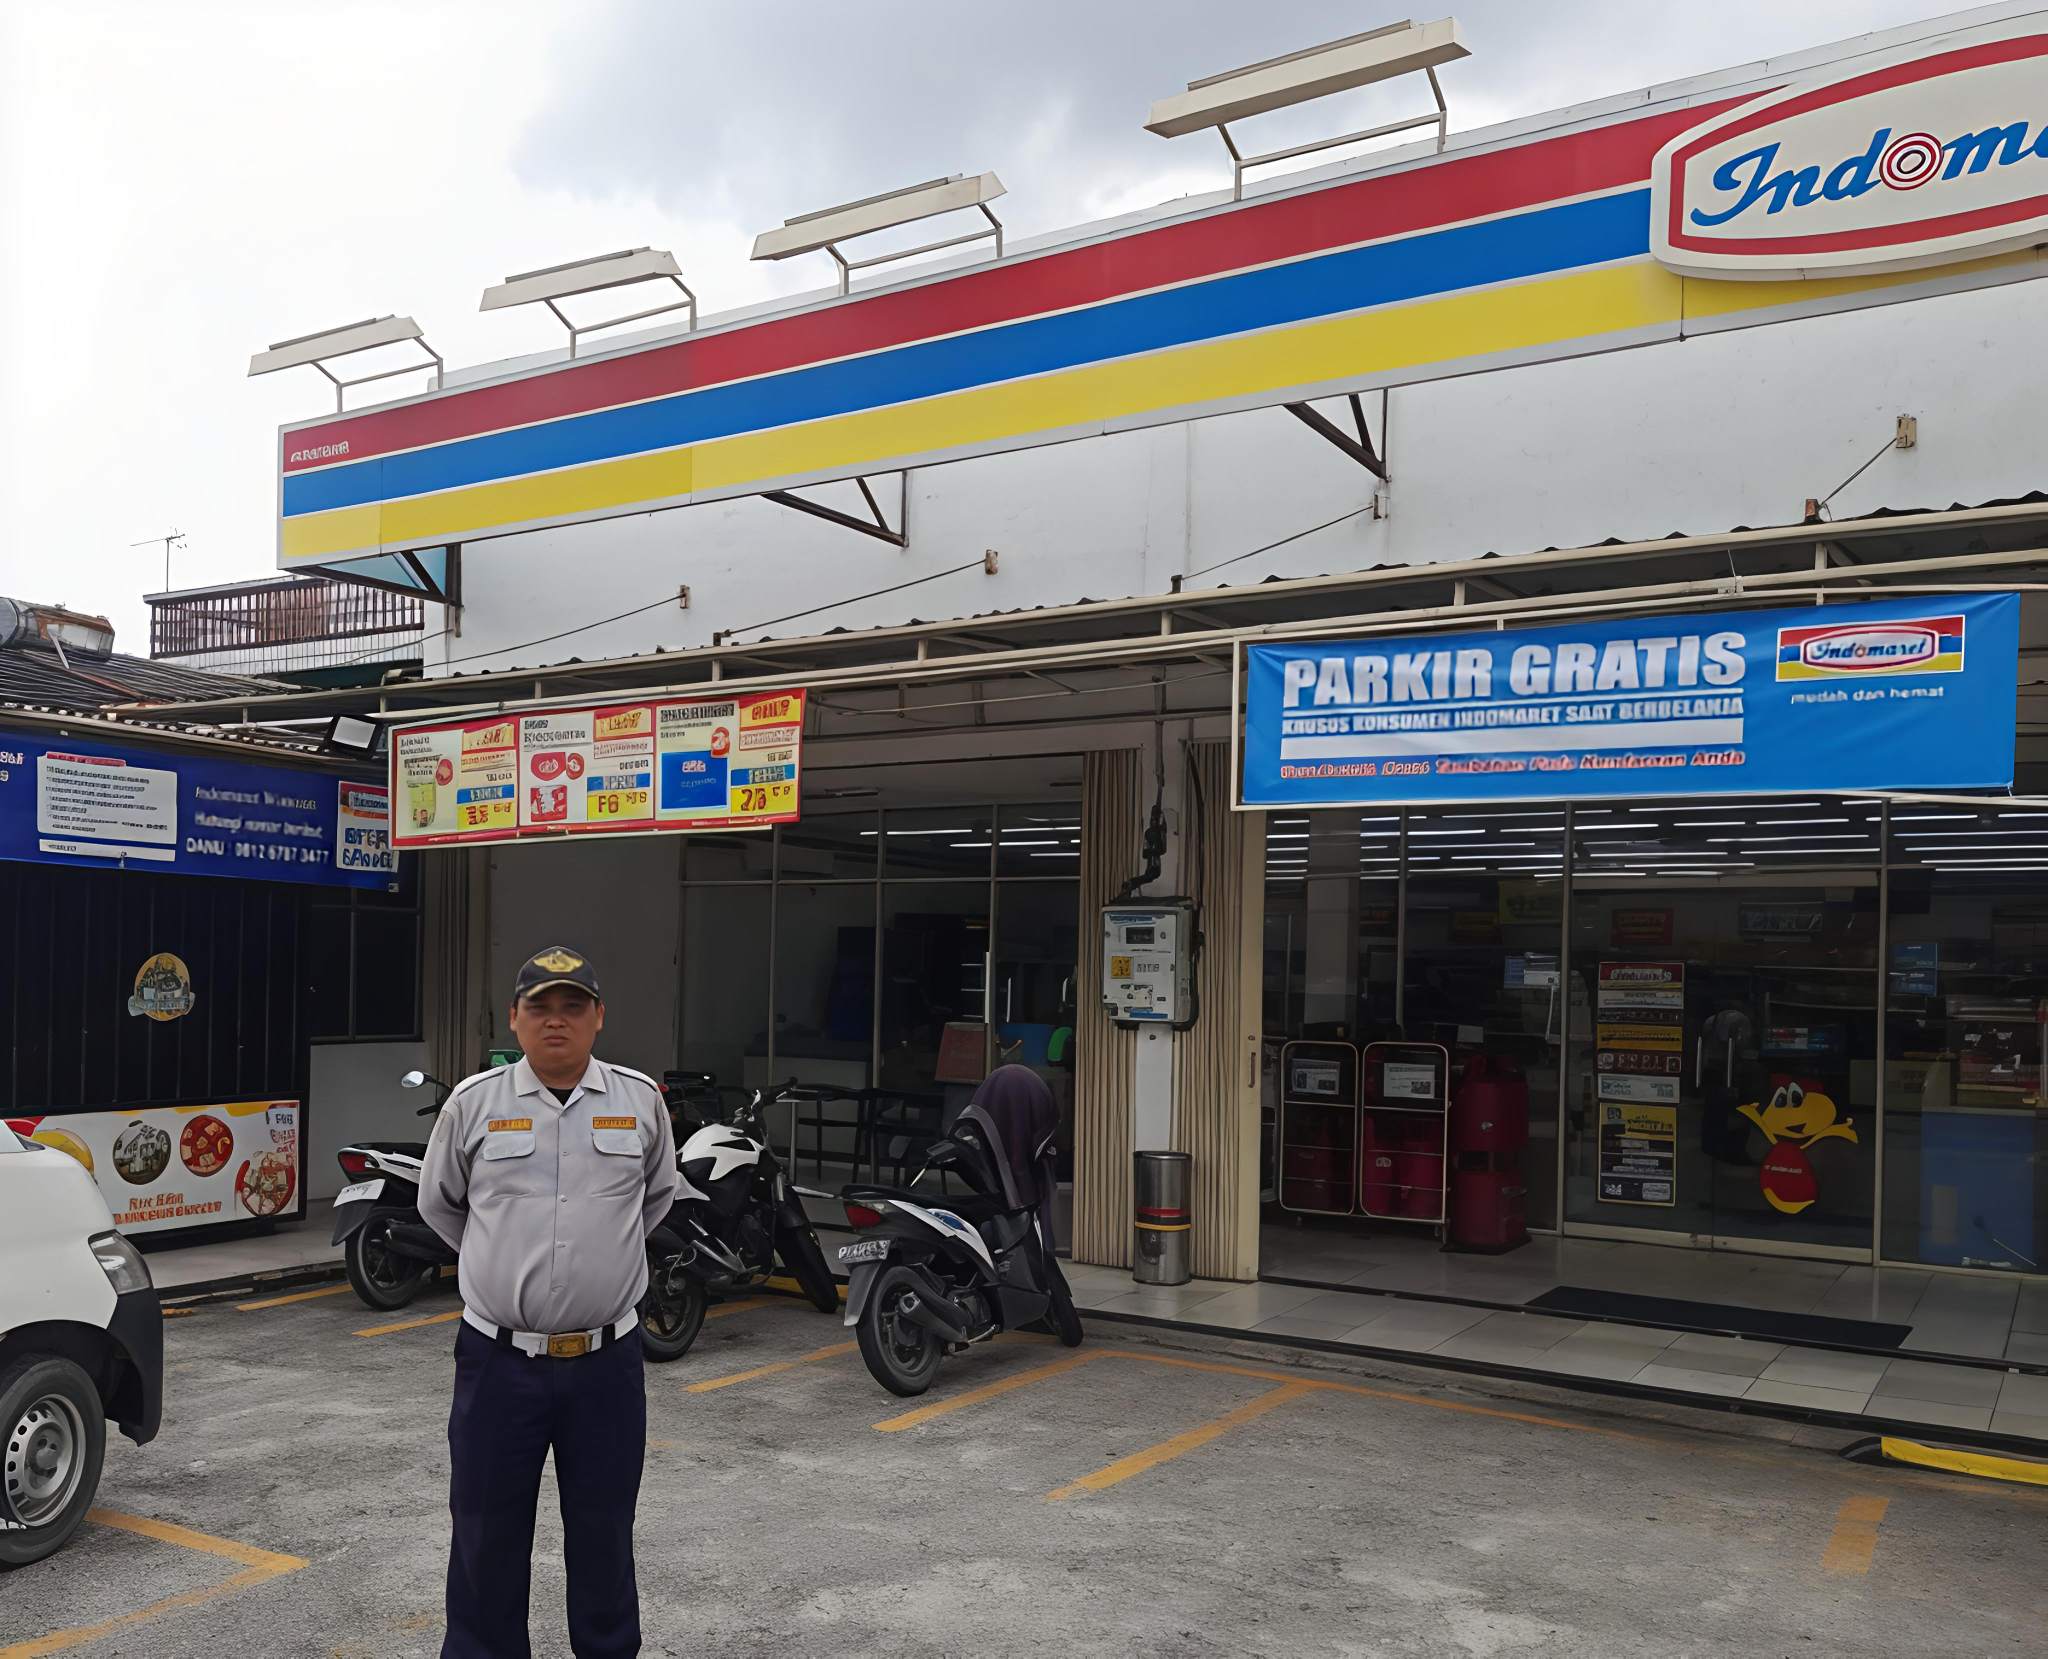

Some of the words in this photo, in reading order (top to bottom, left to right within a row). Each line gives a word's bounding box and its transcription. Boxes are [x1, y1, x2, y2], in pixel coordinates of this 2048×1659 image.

[1690, 121, 2048, 226] Indom
[1811, 638, 1926, 661] Indomaret
[1283, 648, 1493, 707] PARKIR
[1509, 631, 1746, 695] GRATIS
[1791, 689, 1848, 704] mudah
[1852, 687, 1885, 701] dan
[1890, 686, 1944, 699] hemat
[1282, 717, 1349, 735] KHUSUS
[1353, 712, 1449, 732] KONSUMEN
[1454, 705, 1562, 728] INDOMARET
[1566, 702, 1614, 721] SAAT
[1618, 697, 1744, 720] BERBELANJA
[1690, 750, 1746, 766] Anda
[186, 837, 225, 856] DANU
